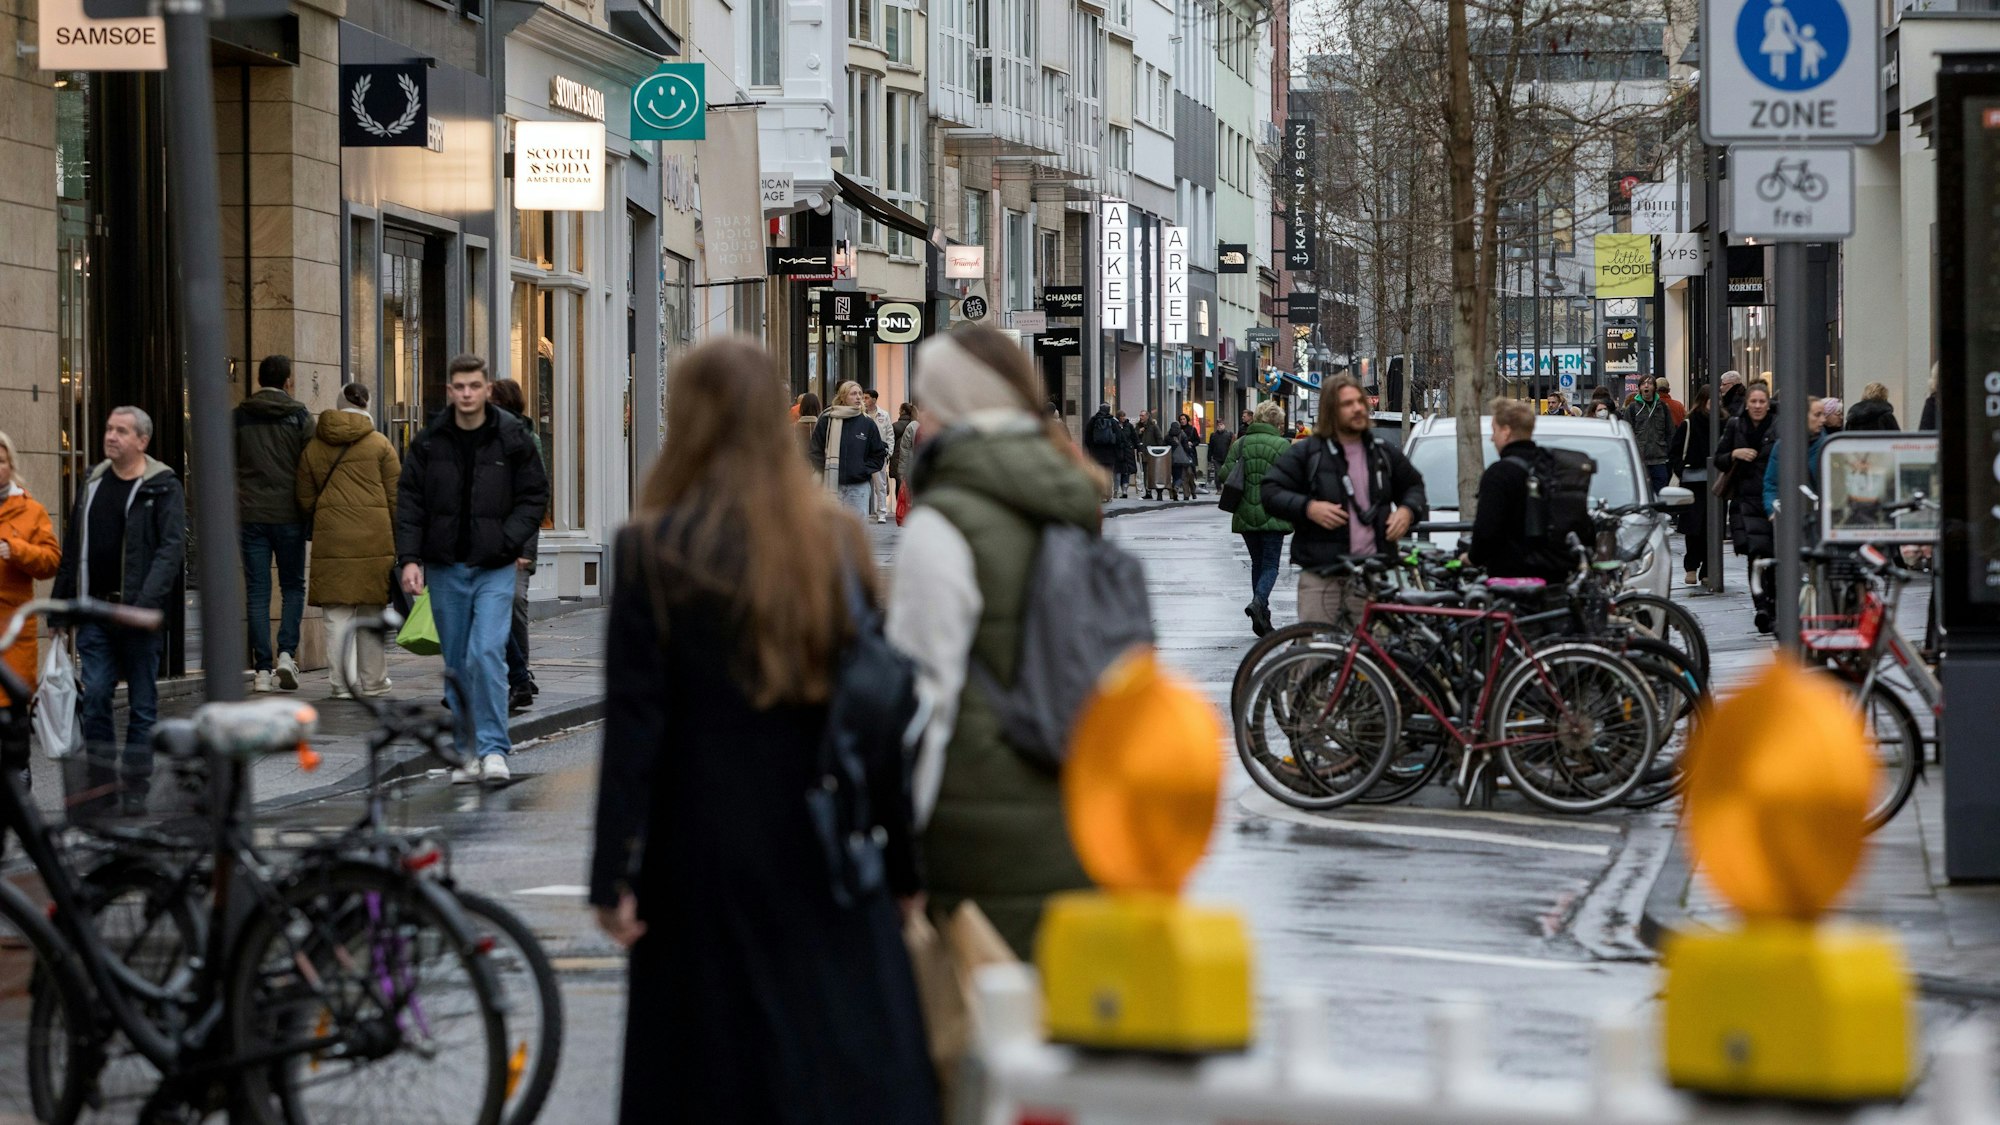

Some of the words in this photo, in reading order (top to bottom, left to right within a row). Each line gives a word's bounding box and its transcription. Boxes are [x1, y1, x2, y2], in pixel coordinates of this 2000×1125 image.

[56, 27, 156, 45] SAMSØE
[556, 75, 582, 114] SCOTCH
[587, 87, 605, 121] SODA
[1750, 100, 1837, 128] ZONE
[1295, 124, 1306, 160] SON
[526, 148, 590, 160] SCOTCH
[545, 162, 590, 174] SODA
[526, 176, 591, 184] AMSTERDAM
[1773, 206, 1813, 227] frei
[1608, 248, 1647, 265] little
[1668, 249, 1698, 260] YPS
[778, 257, 827, 265] MAC
[949, 257, 980, 269] Triumph
[1107, 206, 1123, 325] ARKET
[1602, 264, 1653, 276] FOODIE
[1168, 230, 1183, 340] ARKET
[1728, 283, 1763, 292] KORNER
[878, 317, 919, 329] ONLY
